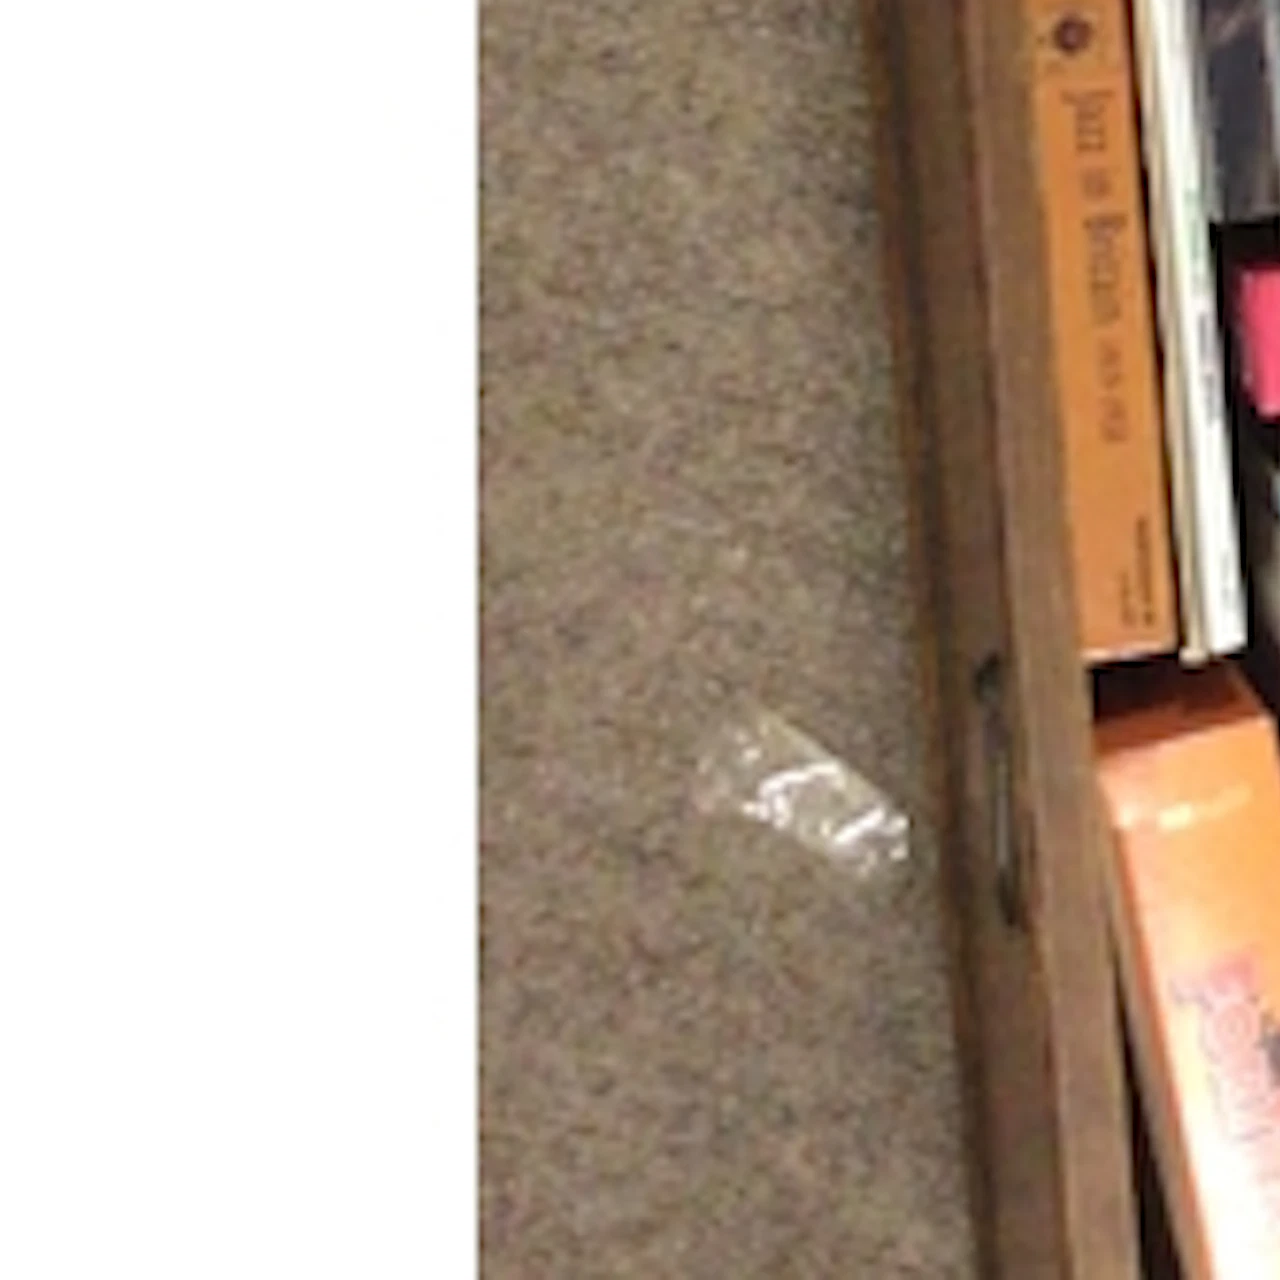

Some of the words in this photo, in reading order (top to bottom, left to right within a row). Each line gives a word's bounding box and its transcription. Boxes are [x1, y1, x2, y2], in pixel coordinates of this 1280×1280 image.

[1056, 88, 1117, 154] Jazz
[1080, 166, 1118, 204] in
[1081, 211, 1128, 327] Britain
